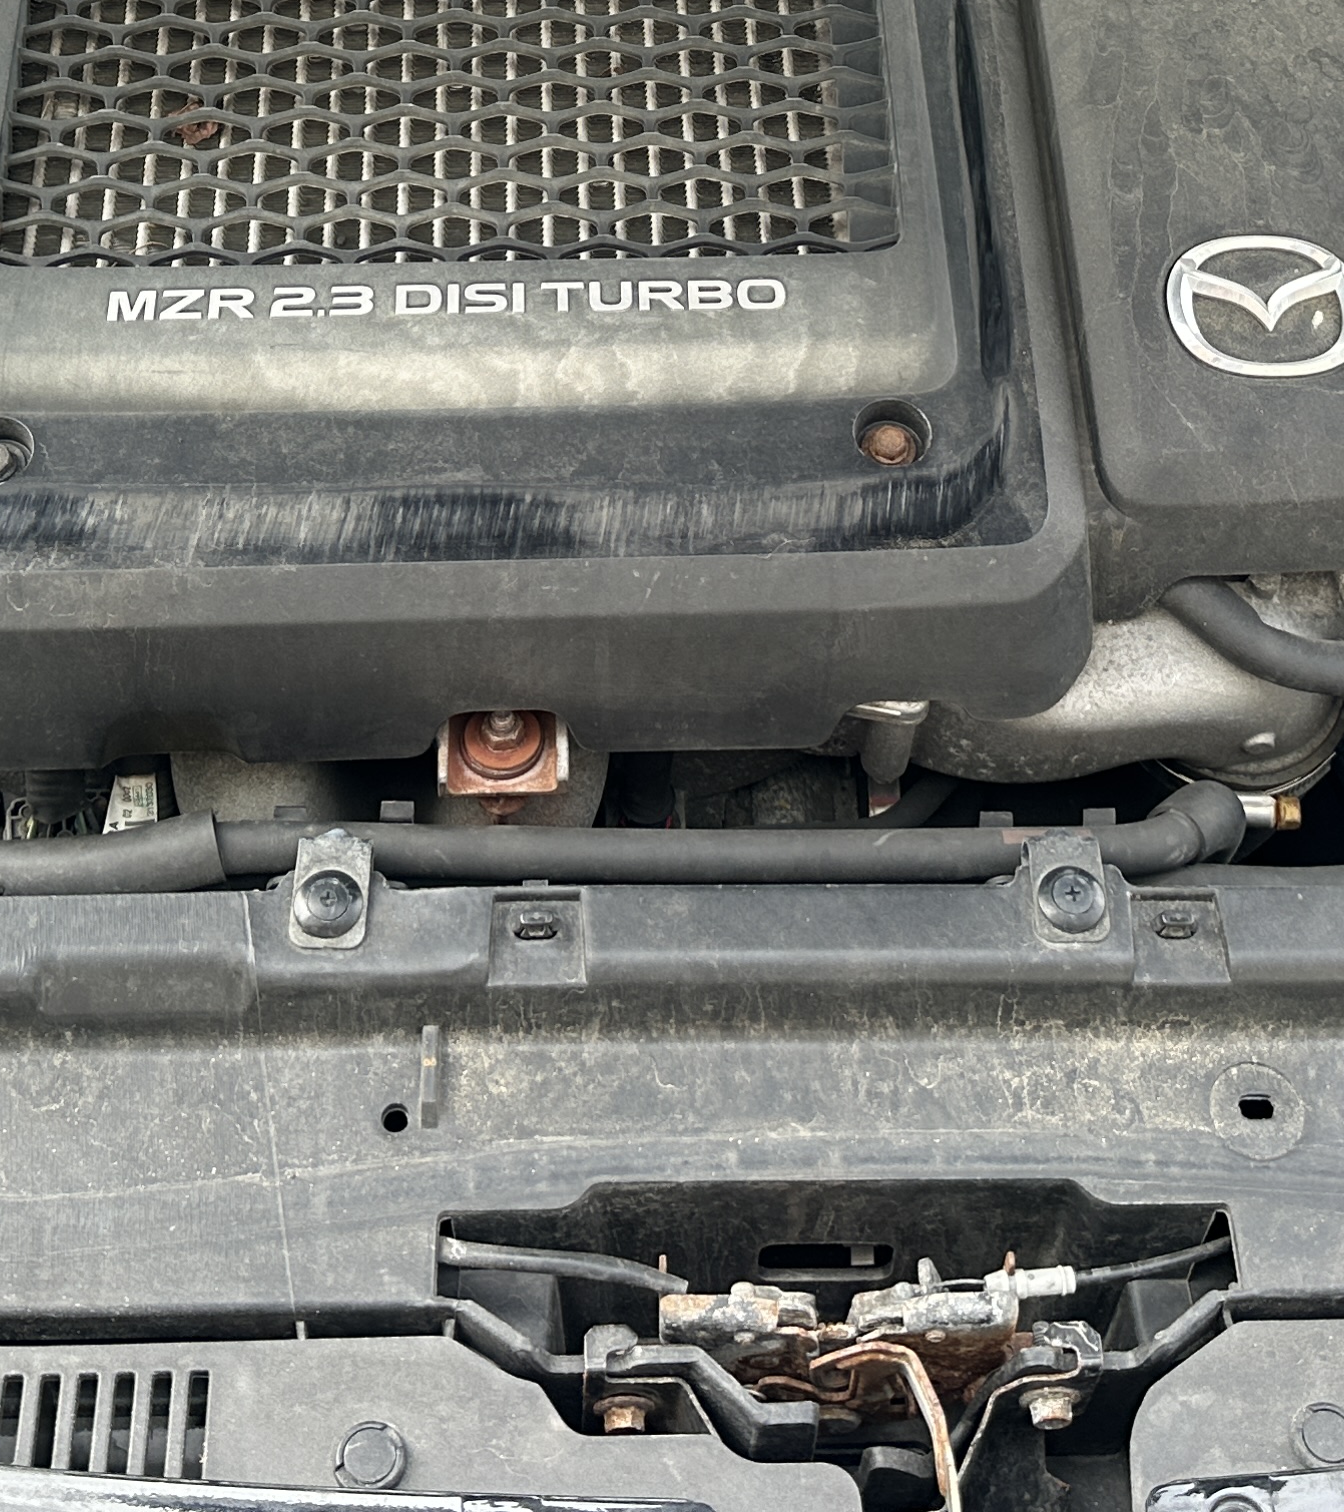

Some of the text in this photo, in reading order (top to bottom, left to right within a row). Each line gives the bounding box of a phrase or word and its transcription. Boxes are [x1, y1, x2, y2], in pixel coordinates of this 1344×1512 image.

[105, 277, 786, 322] MZR 2.3 DISI TURBO
